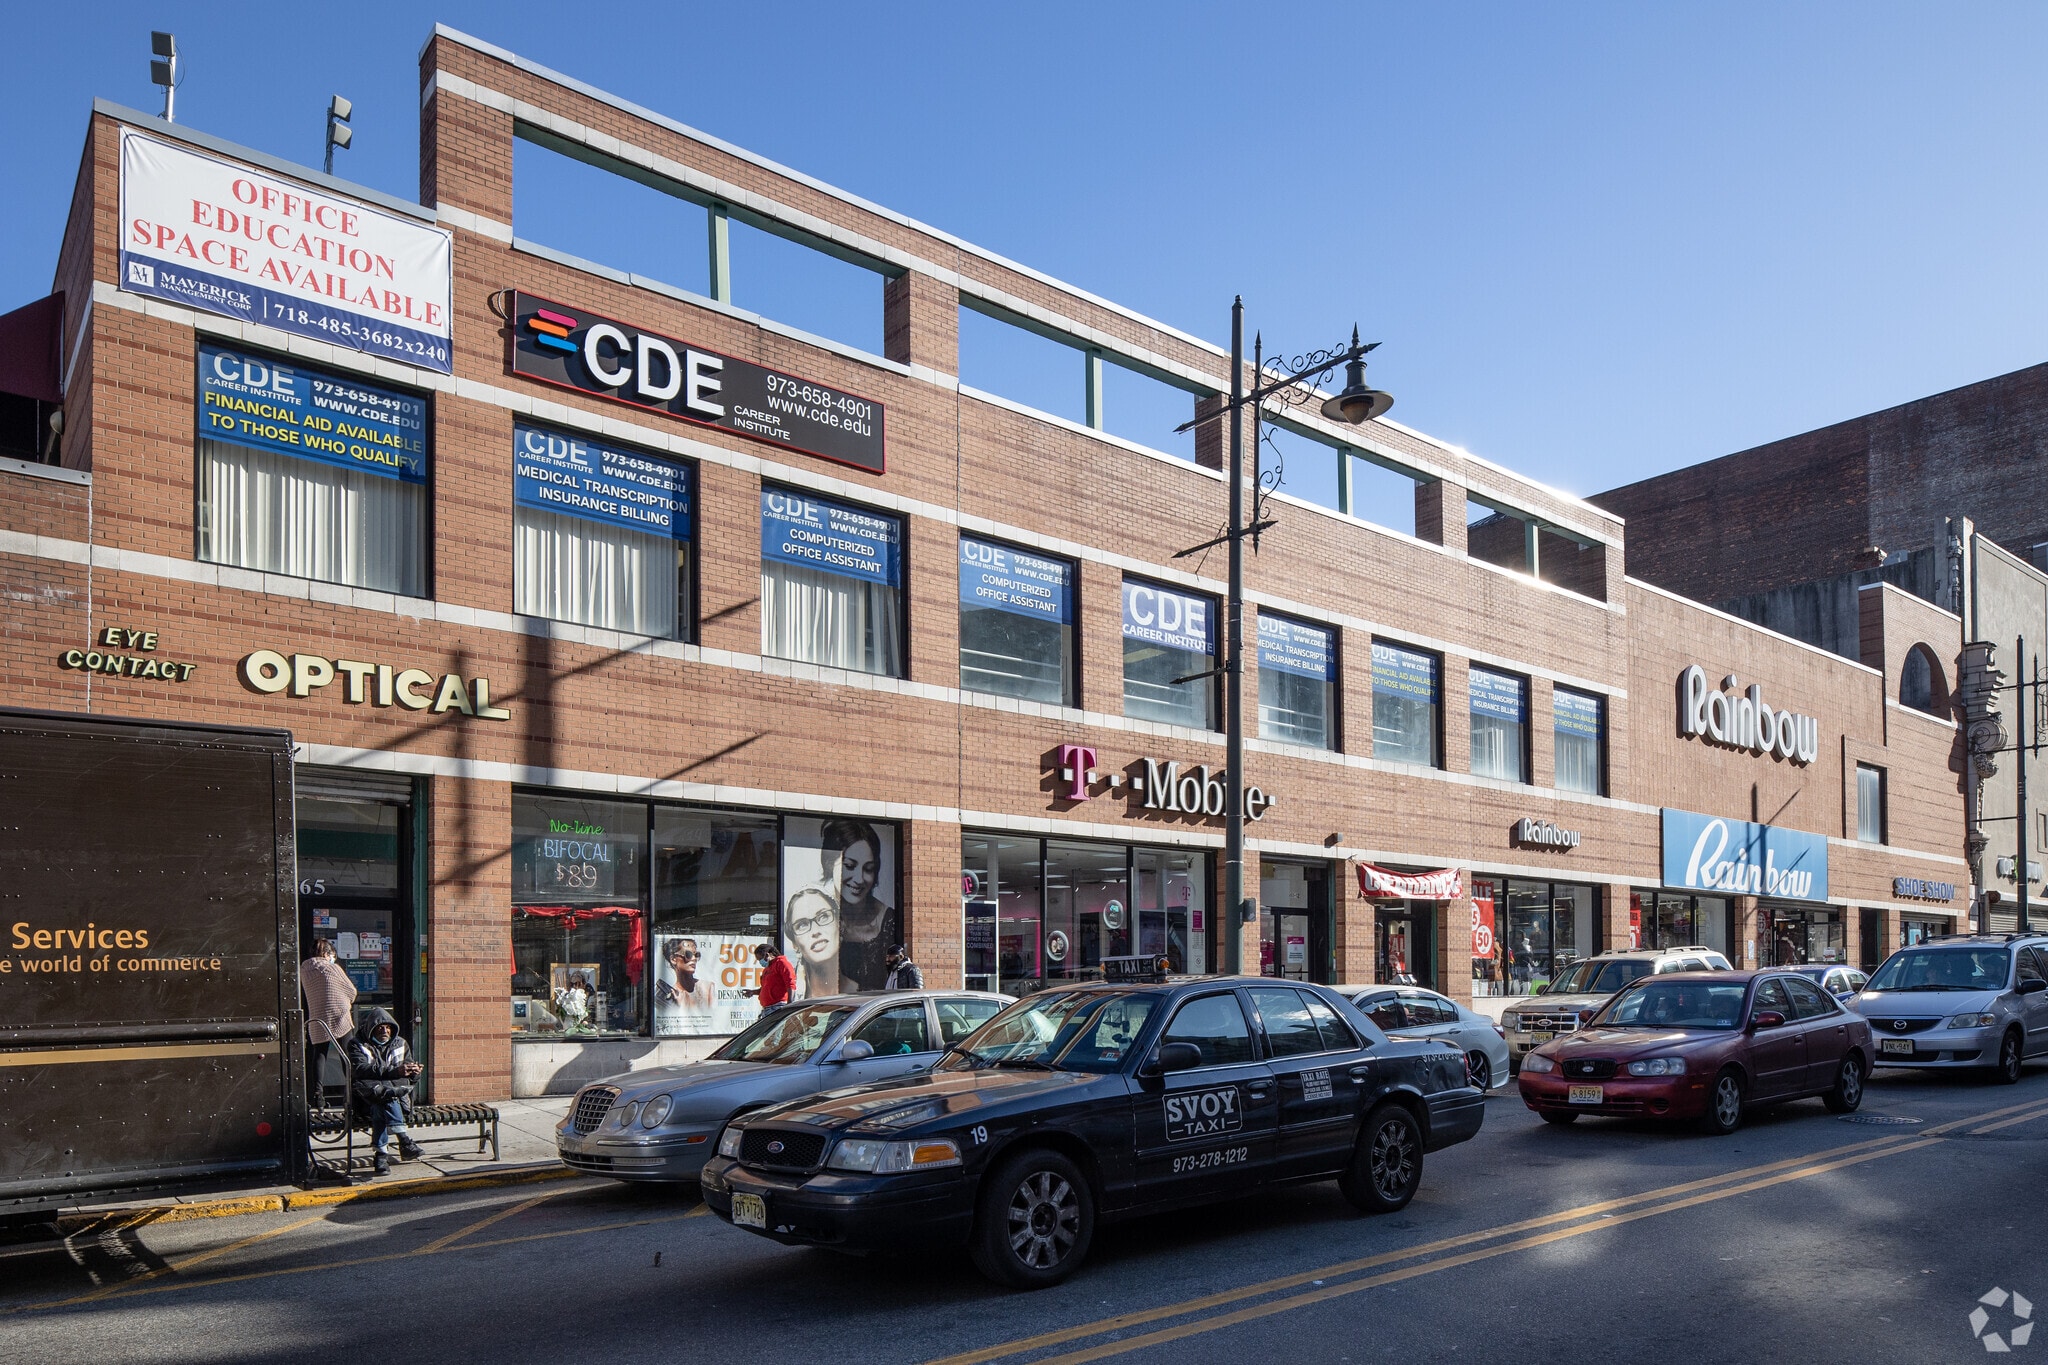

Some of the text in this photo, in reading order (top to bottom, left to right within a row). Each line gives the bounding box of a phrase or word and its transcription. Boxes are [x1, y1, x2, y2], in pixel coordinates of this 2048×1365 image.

[232, 179, 359, 237] OFFICE
[192, 199, 395, 281] EDUCATION
[132, 218, 442, 328] SPACE AVAILABLE
[160, 272, 252, 305] MAVERICK
[160, 282, 251, 311] MANAGEMENT CORP
[274, 304, 446, 362] 718-485-3682x240
[213, 353, 294, 395] CDE
[584, 324, 724, 416] CDE
[206, 378, 301, 405] CAREER INSTITUTE
[314, 380, 419, 415] 973-658-4901
[767, 374, 871, 420] 973-658-4901
[205, 391, 422, 453] FINANCIAL AID AVAILABLE
[314, 396, 419, 430] WWW.CDE.EDU
[734, 406, 781, 425] CAREER
[768, 395, 871, 437] www.cde.edu
[209, 412, 419, 470] TO THOSE WHO QUALIFY
[734, 418, 790, 441] INSTITUTE
[525, 430, 587, 465] CDE
[519, 452, 593, 474] CAREER INSTITUTE
[602, 452, 685, 480] 973-658-4901
[518, 464, 688, 513] MEDICAL TRANSCRIPTION
[603, 465, 685, 493] WWW.CDE.EDU
[539, 487, 669, 525] INSURANCE BILLING
[763, 511, 823, 529] CAREER INSTITUTE
[768, 491, 818, 521] CDE
[830, 509, 896, 532] 973-658-4901
[830, 521, 896, 544] WWW.CDE.EDU
[790, 528, 874, 556] COMPUTERIZED
[783, 543, 881, 573] OFFICE ASSISTANT
[976, 587, 1056, 612] OFFICE ASSISTANT
[982, 574, 1051, 597] COMPUTERIZED
[1130, 586, 1206, 639] CDE
[105, 627, 158, 651] EYE
[1123, 624, 1212, 652] CAREER INSTITUTE
[1257, 639, 1333, 663] MEDICAL TRANSCRIPTION
[65, 649, 196, 682] CONTACT
[1266, 653, 1325, 672] INSURANCE BILLING
[246, 649, 511, 720] OPTICAL
[1381, 679, 1398, 688] THOSE
[1399, 683, 1412, 692] WHO
[1414, 686, 1435, 696] QUALIFY
[1410, 675, 1436, 686] AVAILABLE
[1470, 689, 1487, 698] EDICAL
[1473, 700, 1518, 715] INSURANCE BILLING
[1683, 664, 1817, 764] Rainbow
[1144, 757, 1266, 821] Mobe
[550, 819, 605, 835] No-line
[1522, 817, 1581, 847] Rainbow
[544, 839, 611, 862] BIFOCAL
[1685, 819, 1811, 897] Rainbow
[555, 862, 597, 888] $89
[1896, 877, 1955, 900] SHOE SHOW
[1472, 885, 1491, 901] ALE
[12, 922, 149, 949] Services
[1478, 932, 1489, 947] 50
[21, 955, 82, 973] world
[90, 954, 110, 972] of
[117, 957, 221, 971] commerce
[1119, 960, 1140, 974] TAXI
[1302, 1071, 1328, 1081] TAXI RATE
[1167, 1090, 1235, 1123] SVOY
[1579, 1090, 1595, 1098] 8159
[970, 1125, 988, 1145] 19
[1185, 1118, 1224, 1134] TAXI
[1173, 1147, 1248, 1172] 973-278-1212
